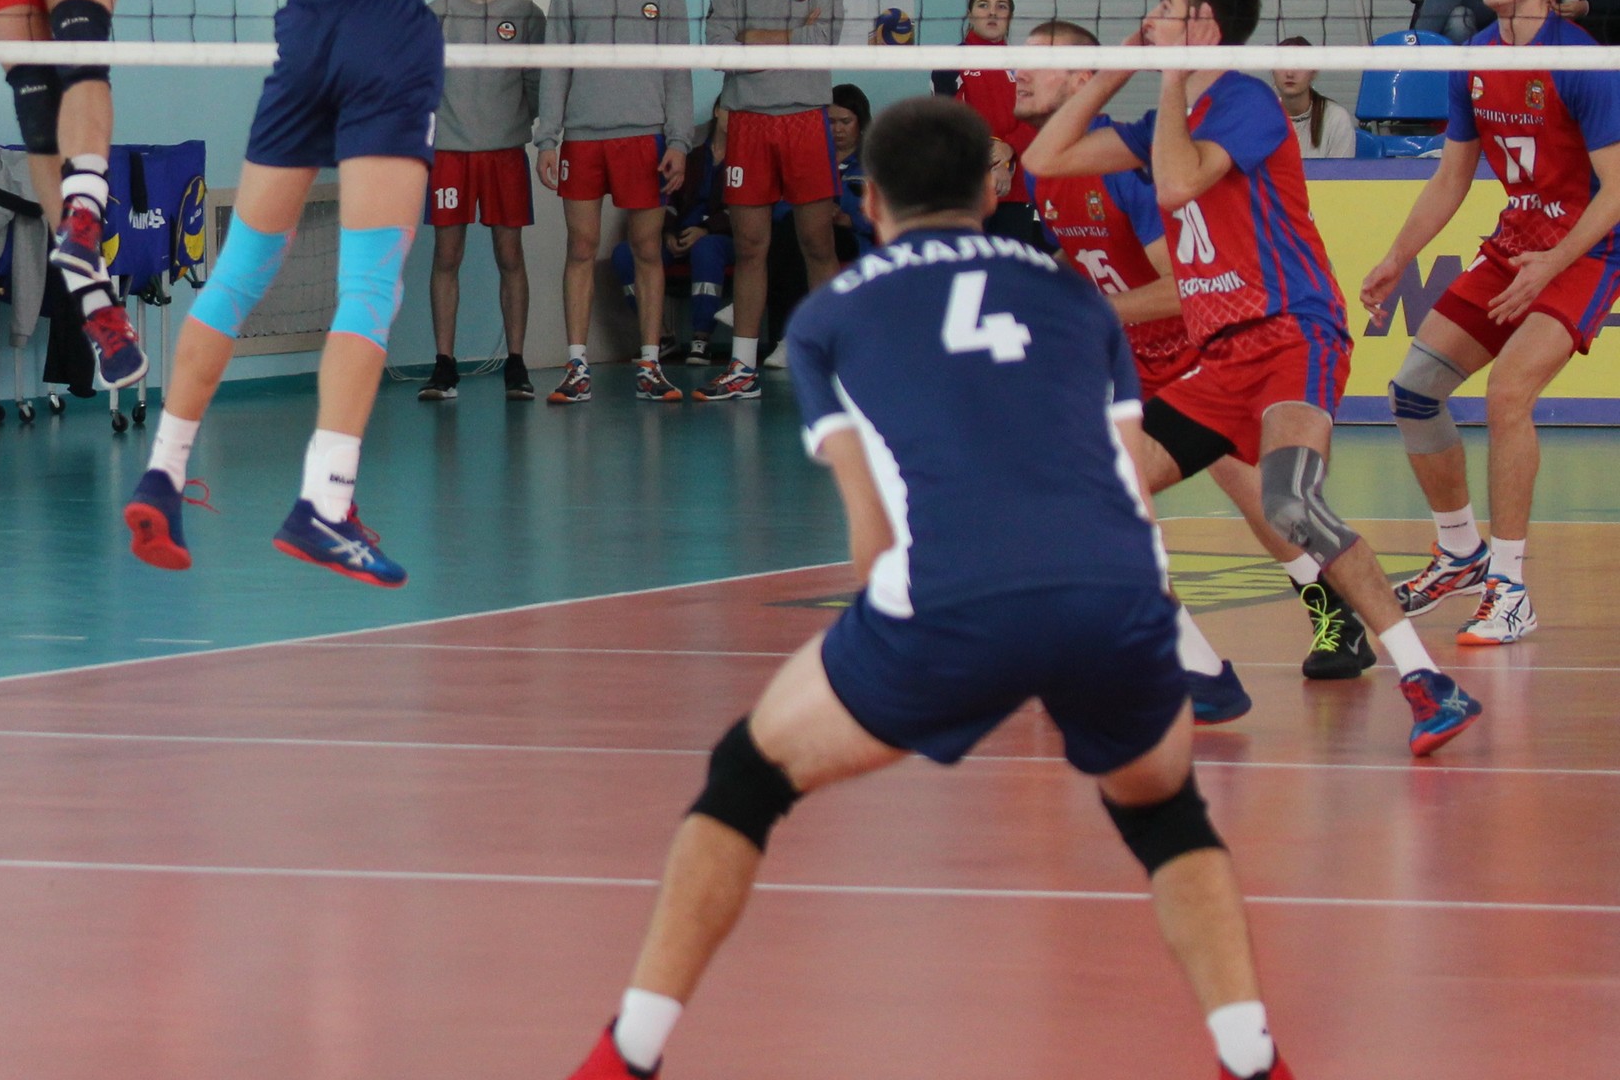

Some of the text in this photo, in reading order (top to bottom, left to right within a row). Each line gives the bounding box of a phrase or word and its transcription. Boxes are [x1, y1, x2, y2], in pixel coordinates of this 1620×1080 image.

[726, 166, 744, 188] 19
[1493, 135, 1536, 185] 17
[435, 187, 459, 209] 18
[941, 270, 1032, 364] 4
